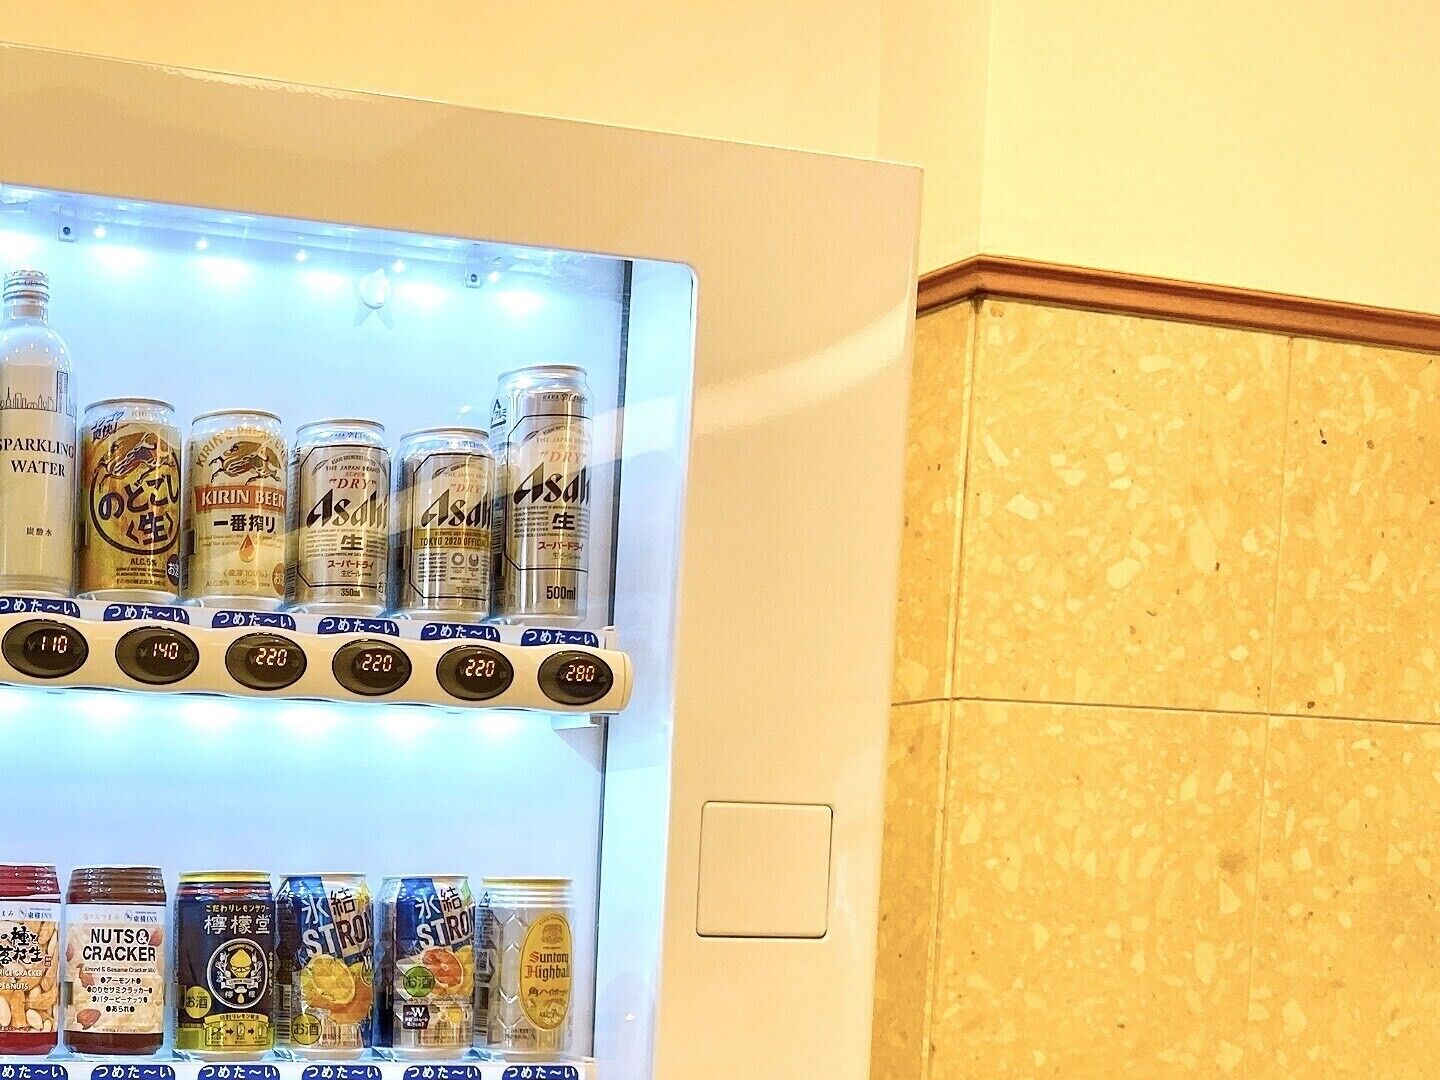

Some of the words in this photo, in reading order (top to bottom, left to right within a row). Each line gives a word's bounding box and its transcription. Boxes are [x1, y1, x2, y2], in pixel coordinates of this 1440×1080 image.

[11, 459, 66, 478] WATER
[98, 475, 180, 521] のどごし
[201, 488, 251, 507] KIRIN
[255, 491, 285, 509] BEER
[306, 488, 388, 530] Asahi
[213, 514, 277, 534] 一番搾り
[552, 512, 576, 531] 生
[25, 526, 53, 537] 炭酸水
[340, 534, 364, 551] 生
[420, 537, 443, 547] TOKYO
[444, 536, 461, 546] 2020
[39, 635, 68, 653] 110
[152, 642, 179, 660] 140
[255, 649, 287, 667] 220
[361, 654, 393, 672] 220
[464, 660, 495, 677] 220
[565, 665, 595, 682] 280
[205, 904, 270, 913] こだわりレモンサワー
[204, 914, 271, 935] 檸檬堂
[82, 946, 156, 962] CRACKER
[293, 1023, 319, 1036] お酒
